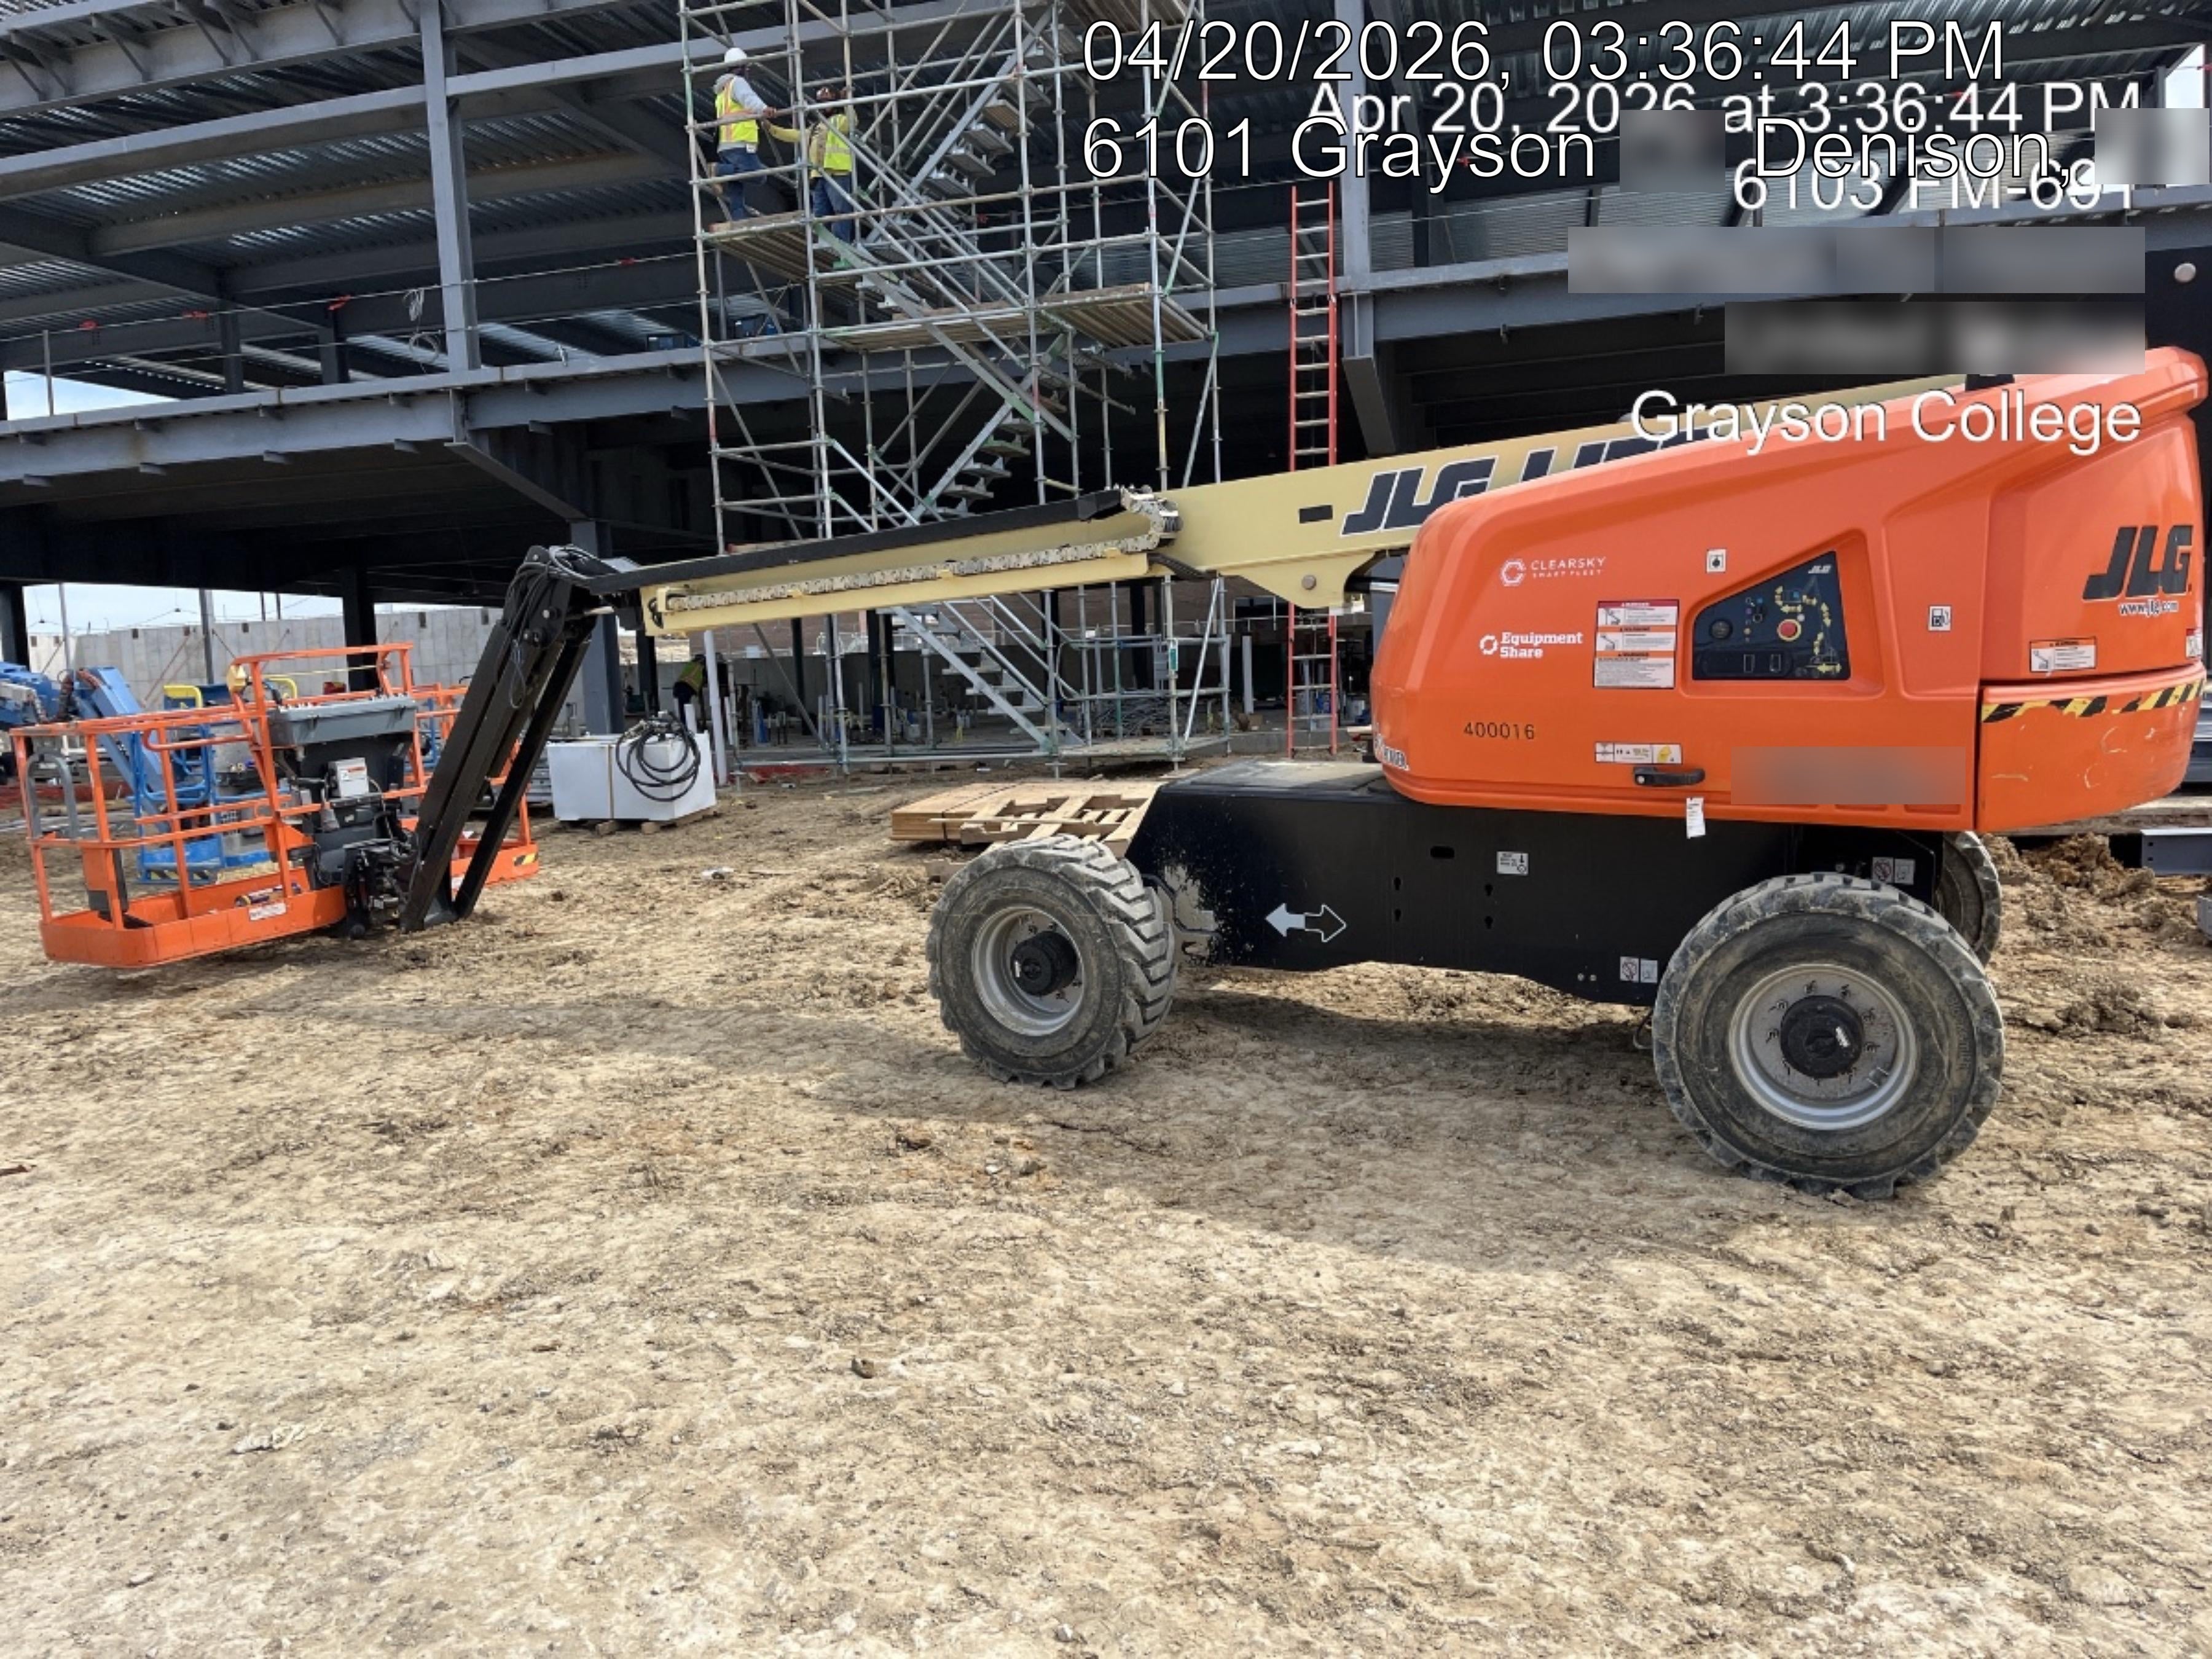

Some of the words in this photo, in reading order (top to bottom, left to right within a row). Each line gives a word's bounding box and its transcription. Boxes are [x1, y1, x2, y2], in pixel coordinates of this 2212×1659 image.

[1341, 455, 1499, 536] JLG
[1531, 557, 1606, 570] CLEARSKY
[2082, 525, 2192, 601] JLG
[2119, 600, 2179, 618] www.jlg.com
[1500, 631, 1583, 646] Equipment
[1500, 646, 1543, 659] Share
[1464, 721, 1535, 740] 400016
